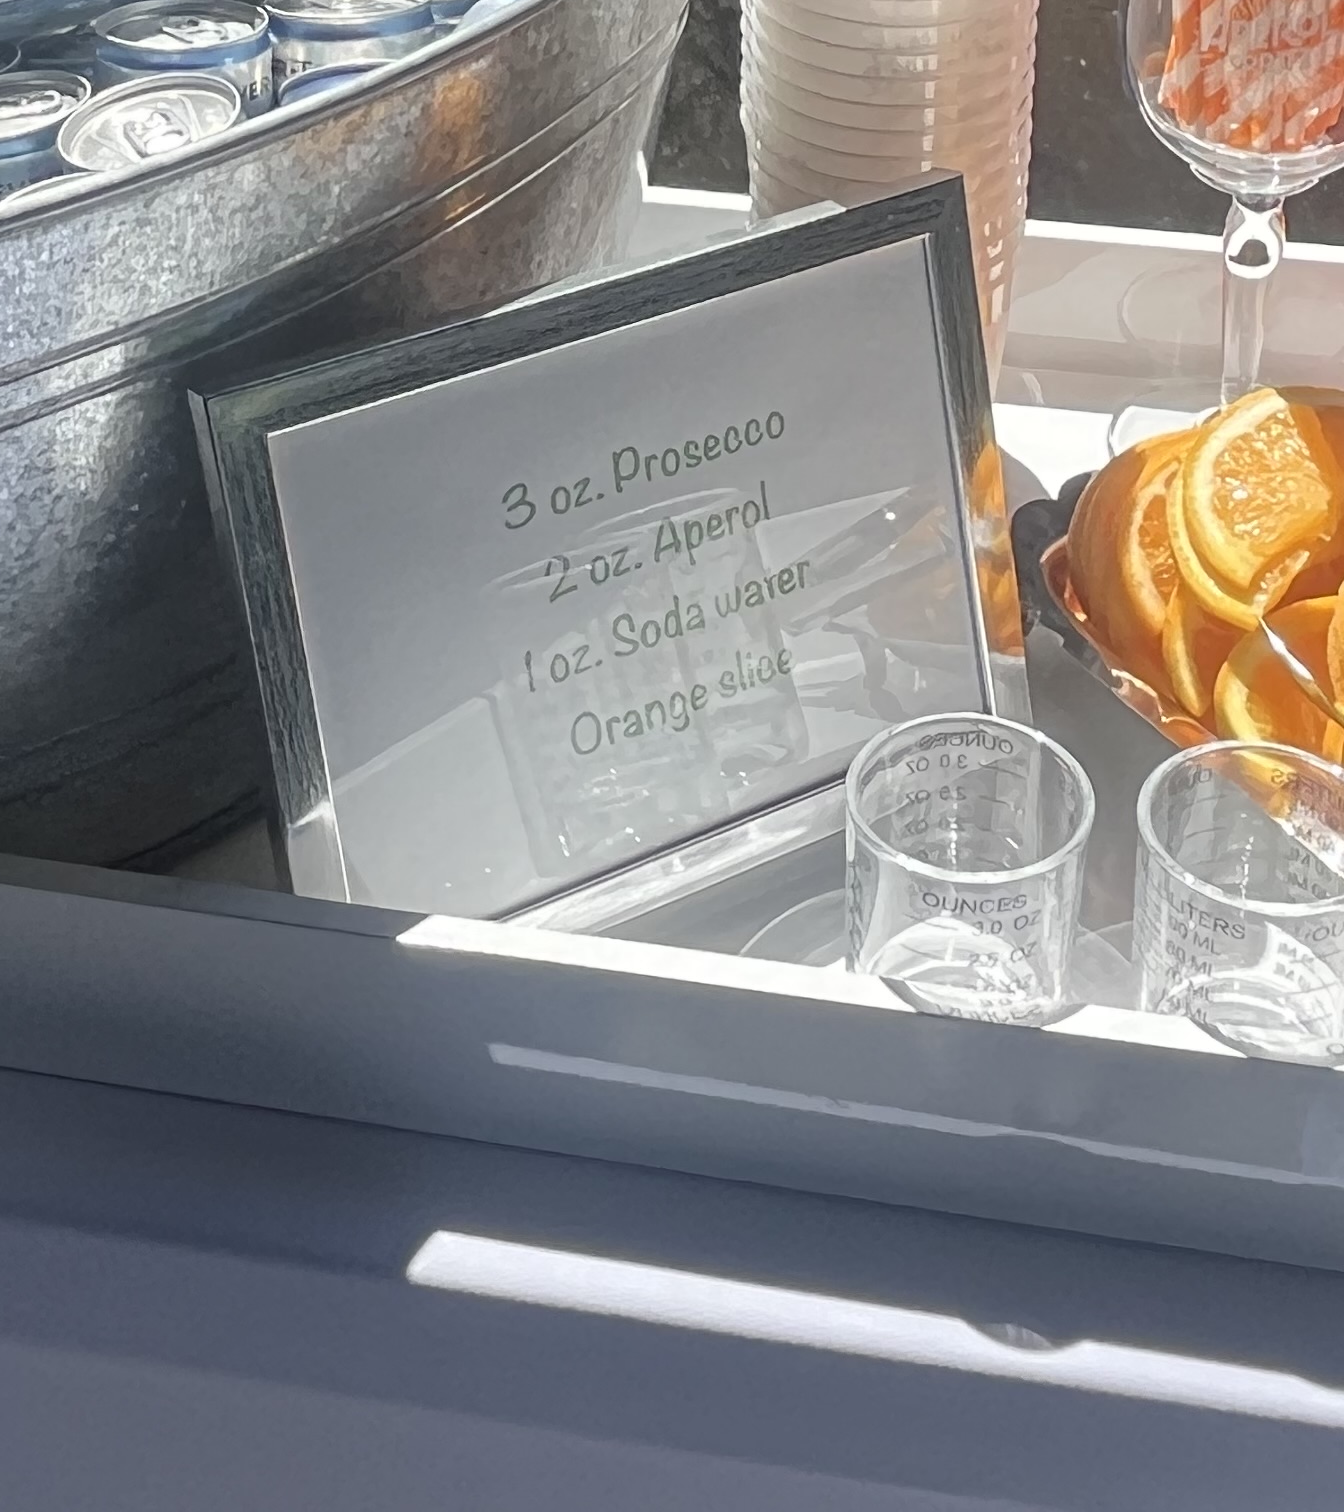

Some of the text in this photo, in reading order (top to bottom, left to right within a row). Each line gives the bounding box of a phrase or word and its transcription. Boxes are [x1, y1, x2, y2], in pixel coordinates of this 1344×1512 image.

[501, 410, 786, 530] 3 oz. Prosecco
[543, 479, 772, 604] 2 oz. Aperol
[523, 649, 537, 693] 1
[549, 644, 604, 684] oz.
[611, 594, 707, 658] Soda
[570, 645, 795, 755] Orange slice
[921, 892, 1028, 916] OUNCES
[1013, 909, 1043, 931] OZ
[1193, 930, 1222, 956] ML
